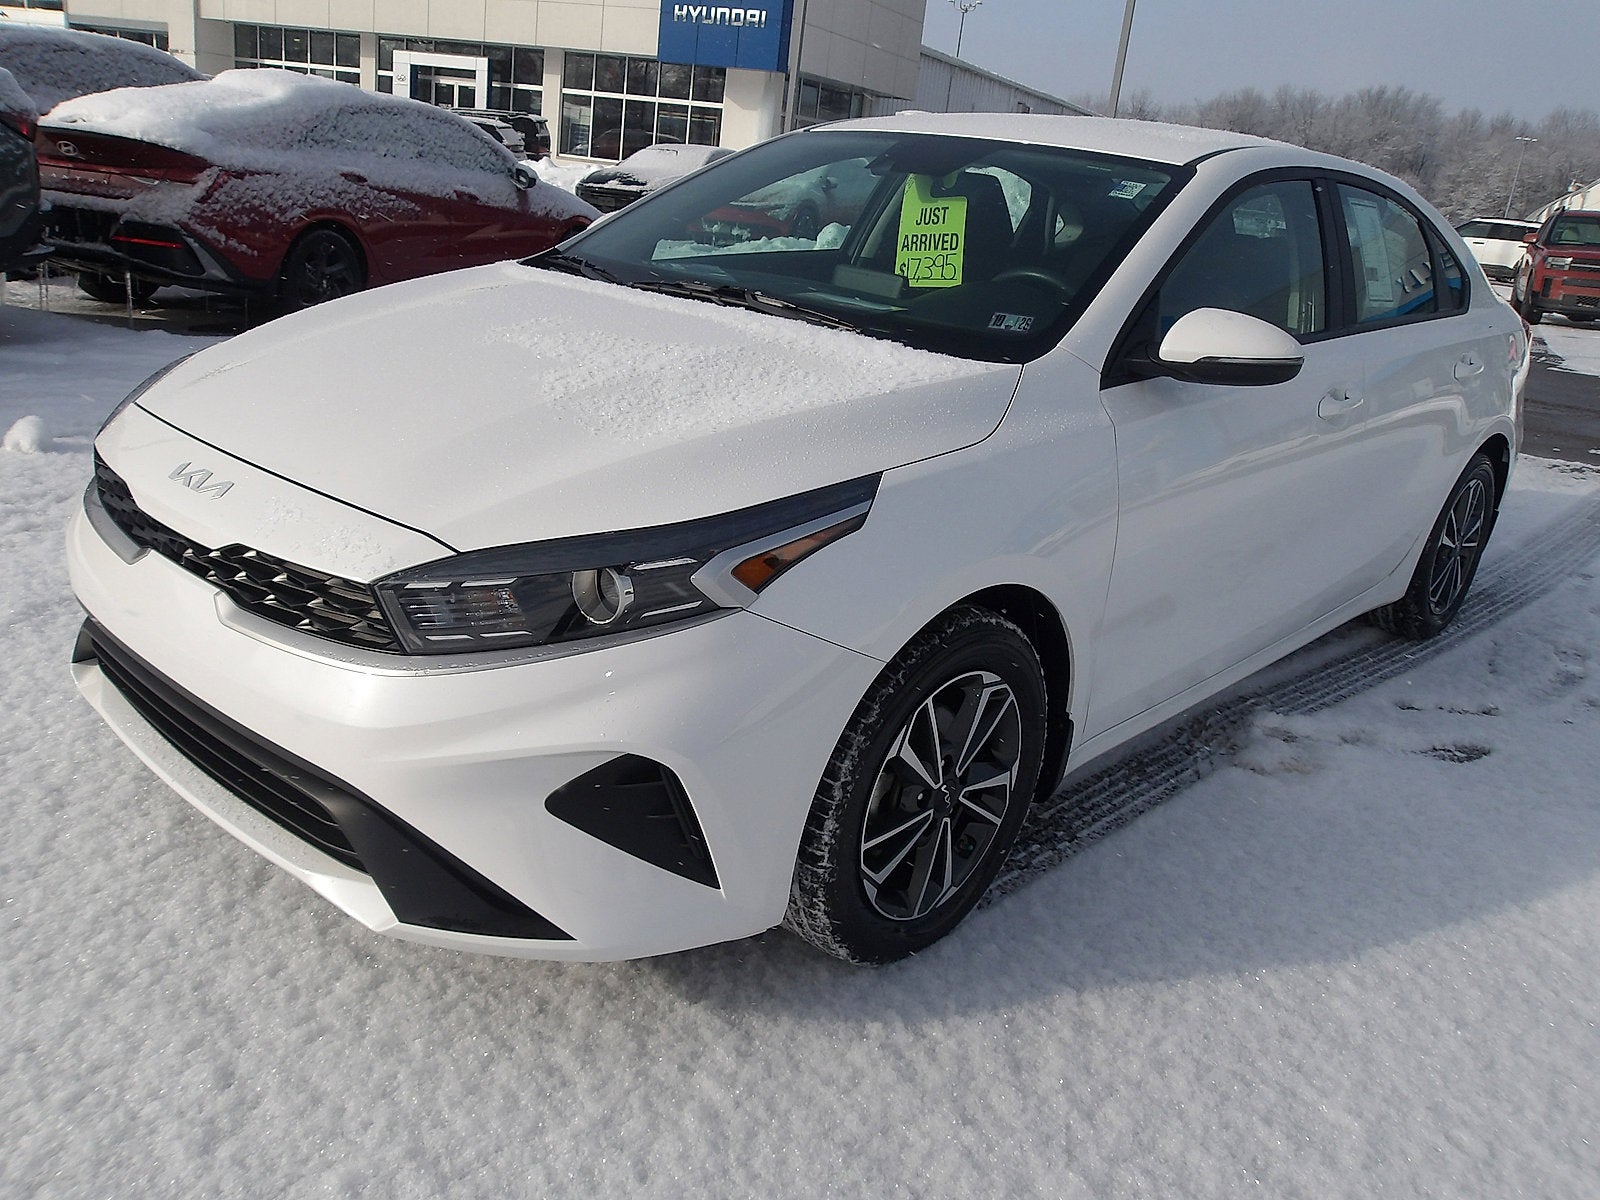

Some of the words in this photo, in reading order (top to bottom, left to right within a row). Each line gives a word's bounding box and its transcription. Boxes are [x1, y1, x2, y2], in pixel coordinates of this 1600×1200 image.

[673, 4, 767, 28] HYUNDAI
[915, 206, 949, 226] JUST
[901, 232, 959, 252] ARRIVED
[167, 461, 235, 501] KIA
